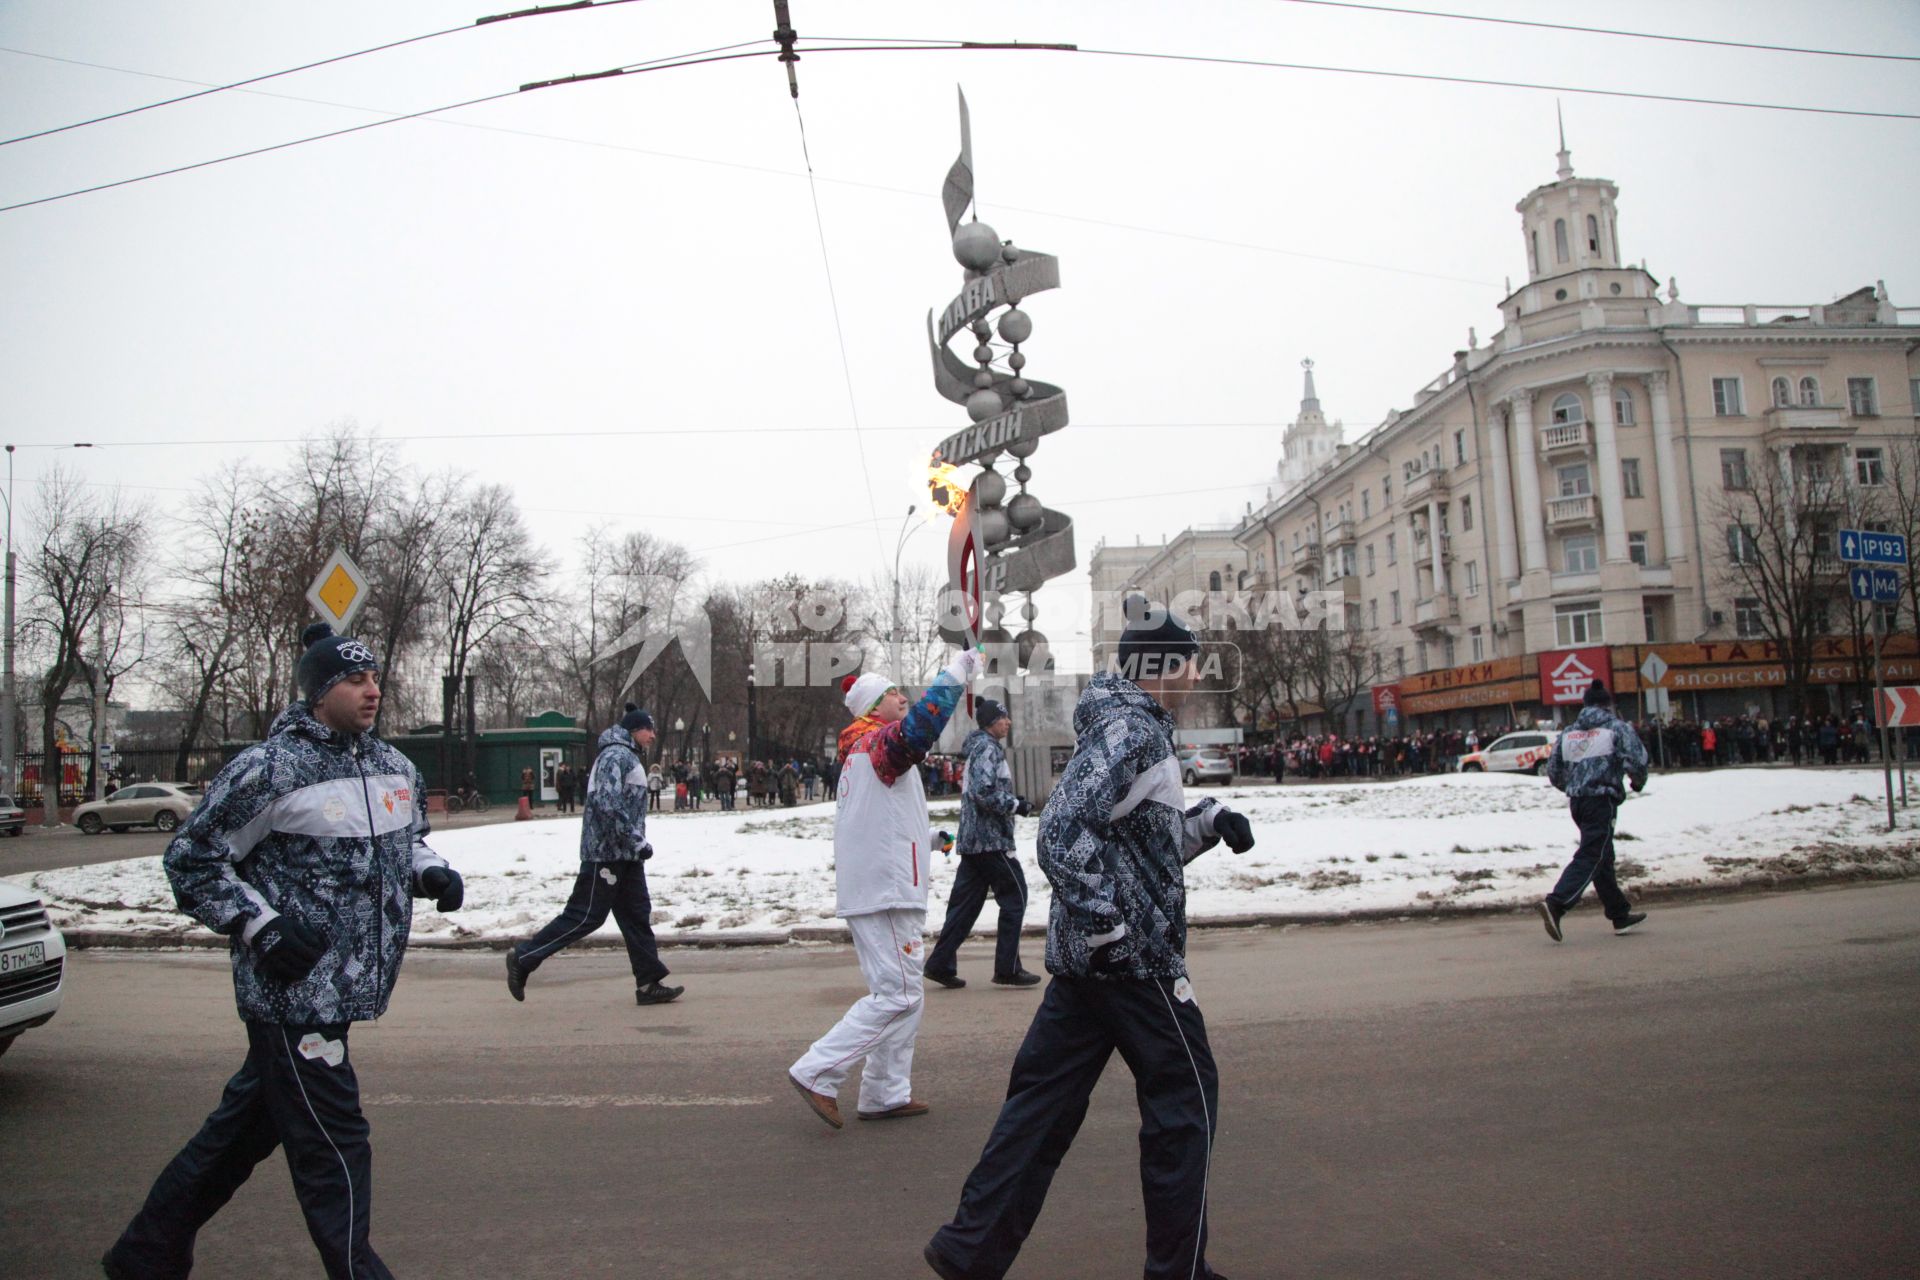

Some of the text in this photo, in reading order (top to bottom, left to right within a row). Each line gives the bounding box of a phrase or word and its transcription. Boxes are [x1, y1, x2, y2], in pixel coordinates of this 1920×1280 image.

[1863, 539, 1902, 557] 1Р193
[1875, 578, 1897, 594] М4
[1700, 637, 1884, 662] ТАНК
[1420, 664, 1494, 690] ТАНУКИ
[1806, 664, 1913, 680] ЕСТАН
